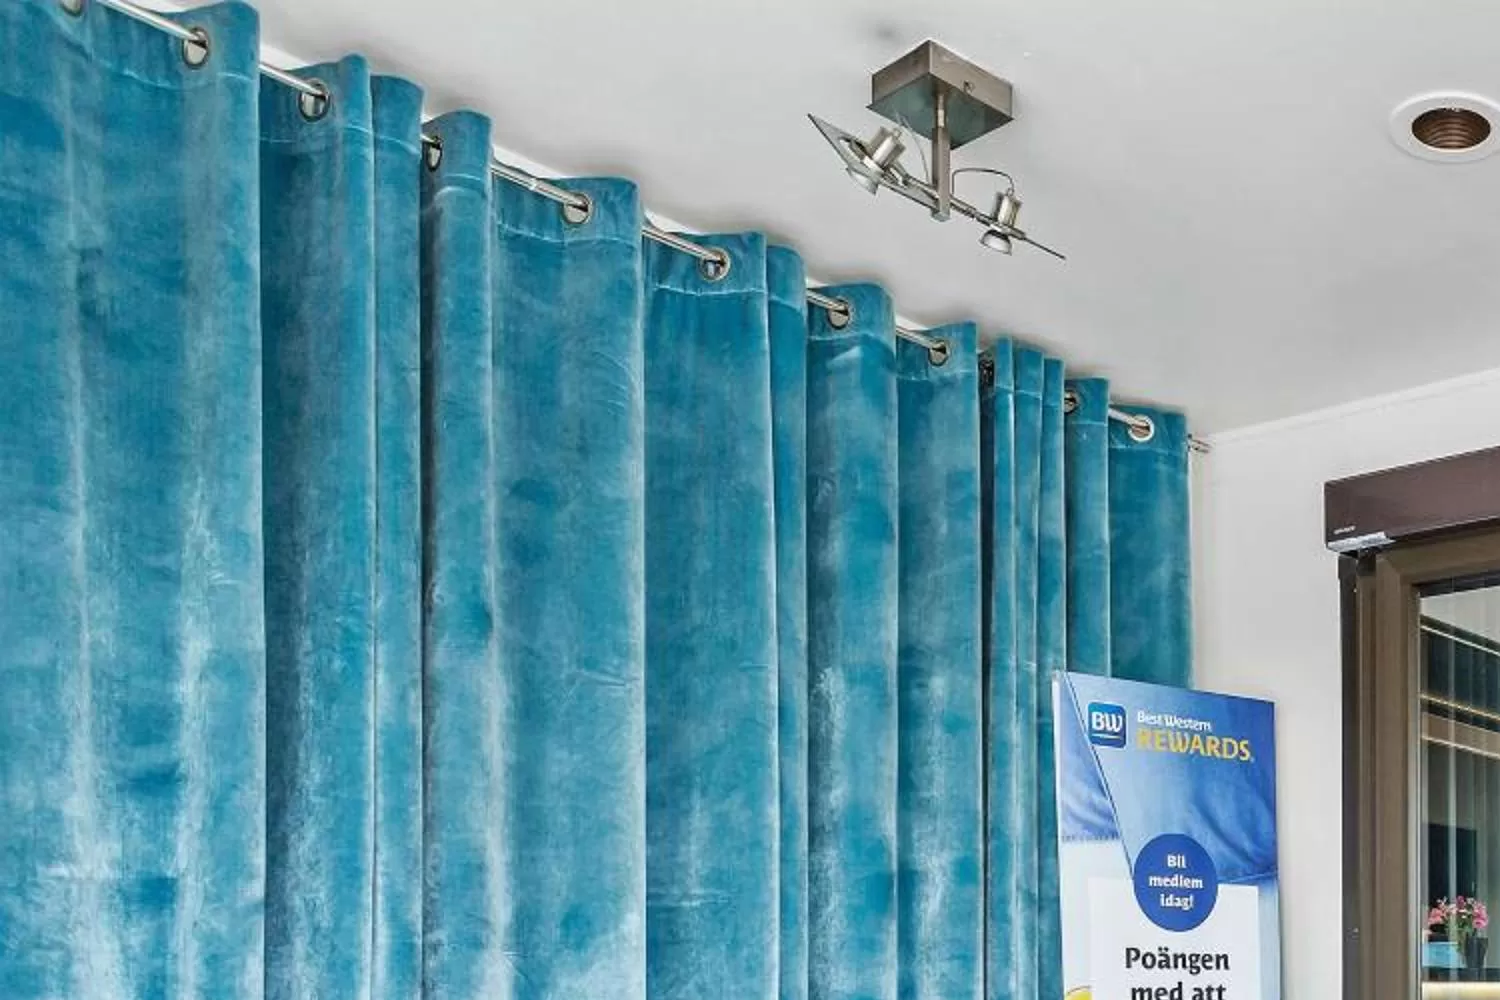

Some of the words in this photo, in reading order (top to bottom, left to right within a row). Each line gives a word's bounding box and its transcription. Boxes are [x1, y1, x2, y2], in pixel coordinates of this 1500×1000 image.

[1091, 711, 1123, 732] BW
[1137, 711, 1162, 725] Best
[1164, 715, 1211, 731] Western
[1136, 729, 1251, 761] REWARDS
[1148, 874, 1203, 888] medlem
[1160, 894, 1194, 911] idag!
[1125, 946, 1230, 976] Poängen
